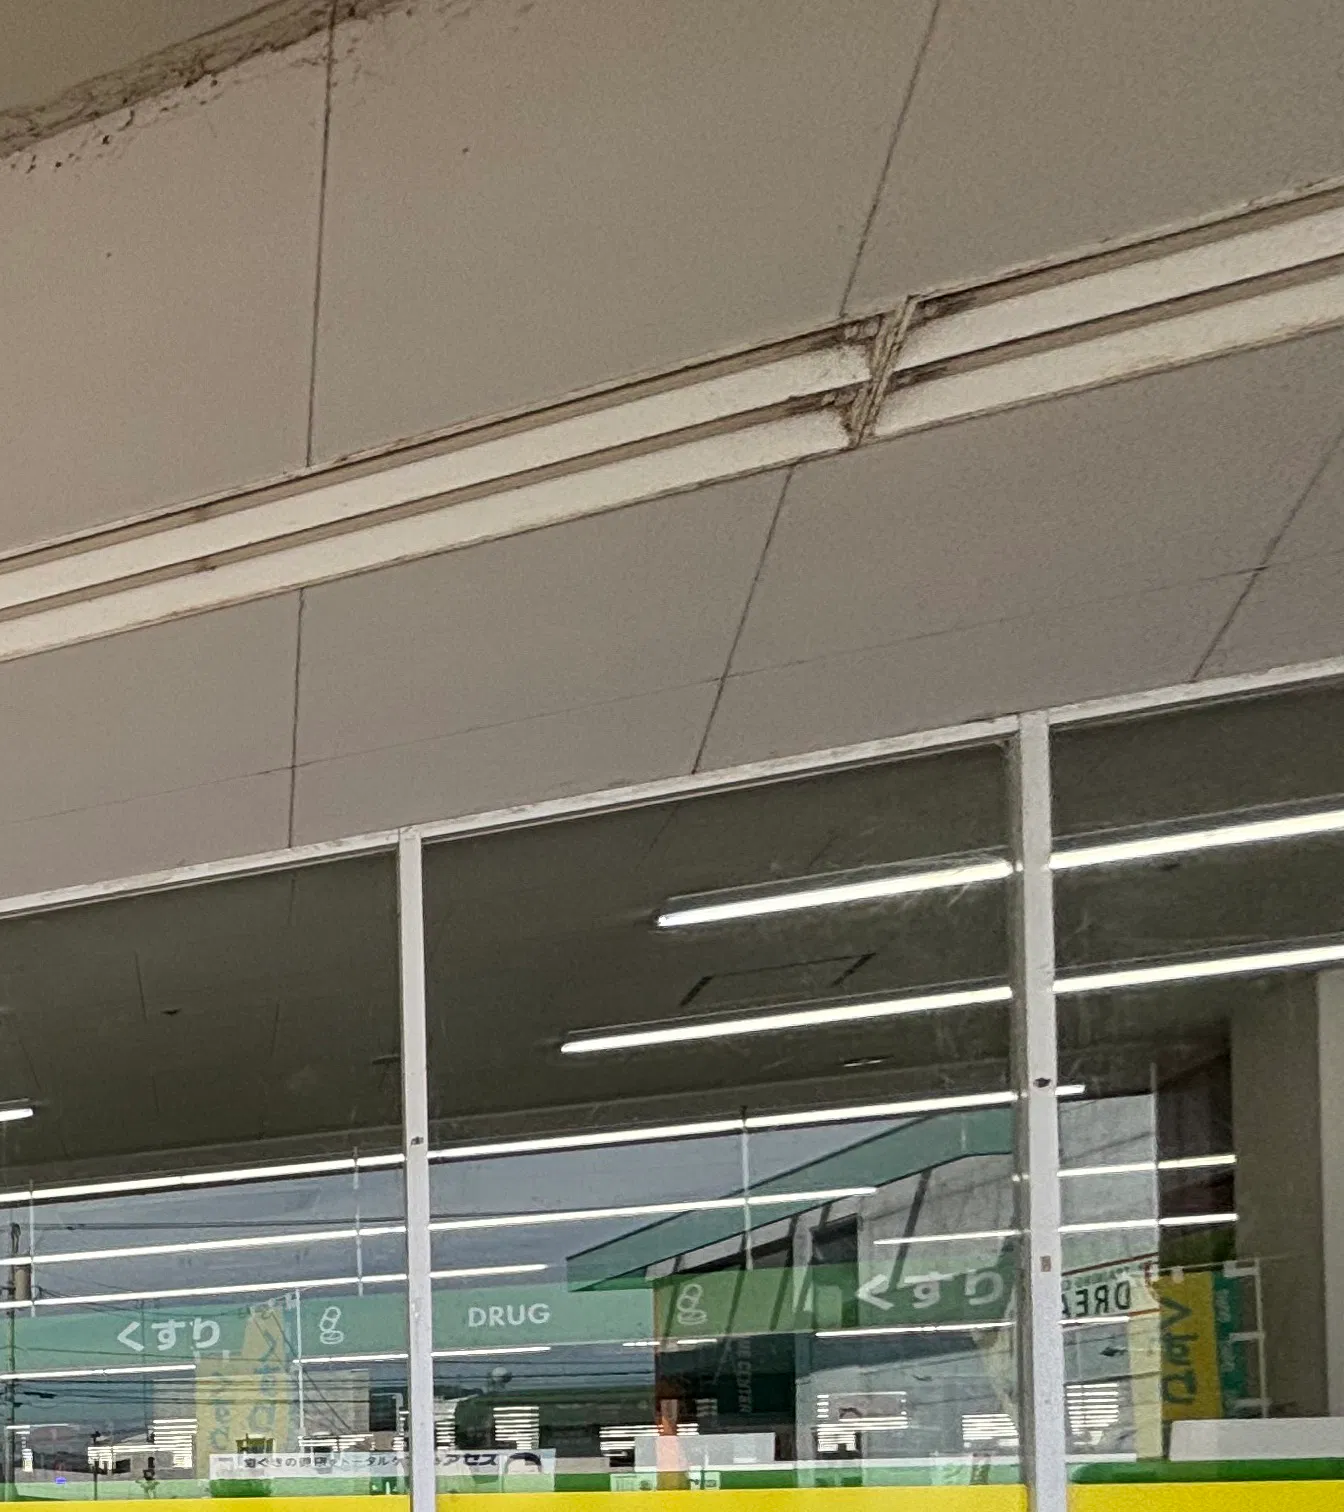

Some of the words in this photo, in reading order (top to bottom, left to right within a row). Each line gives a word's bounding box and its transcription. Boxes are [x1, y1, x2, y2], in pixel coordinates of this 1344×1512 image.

[468, 1303, 551, 1328] DRUG
[117, 1318, 221, 1352] くすり
